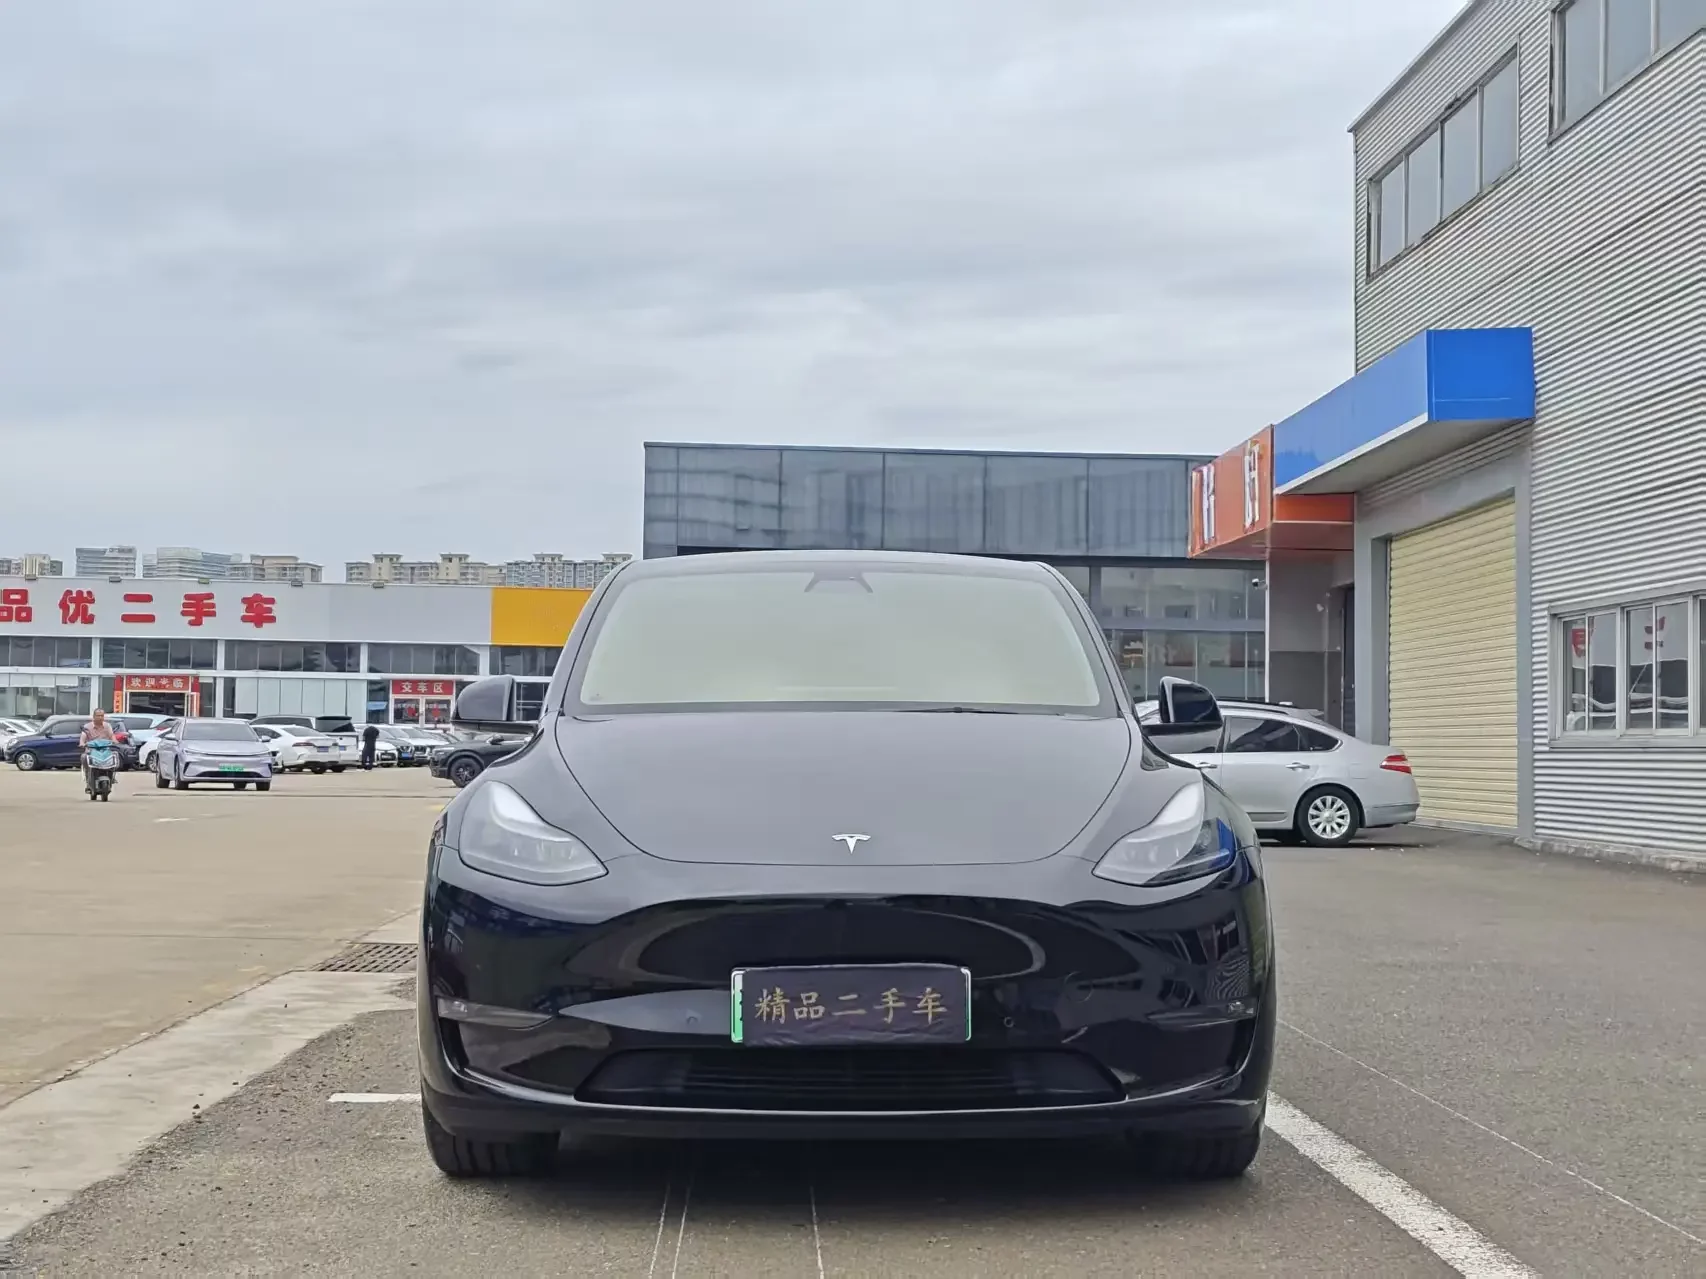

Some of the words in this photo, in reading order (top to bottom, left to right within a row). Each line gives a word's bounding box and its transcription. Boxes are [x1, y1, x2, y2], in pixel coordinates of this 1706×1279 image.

[0, 588, 277, 628] 品优二手车
[400, 681, 444, 693] 交车区
[753, 986, 949, 1025] 精品二手车
